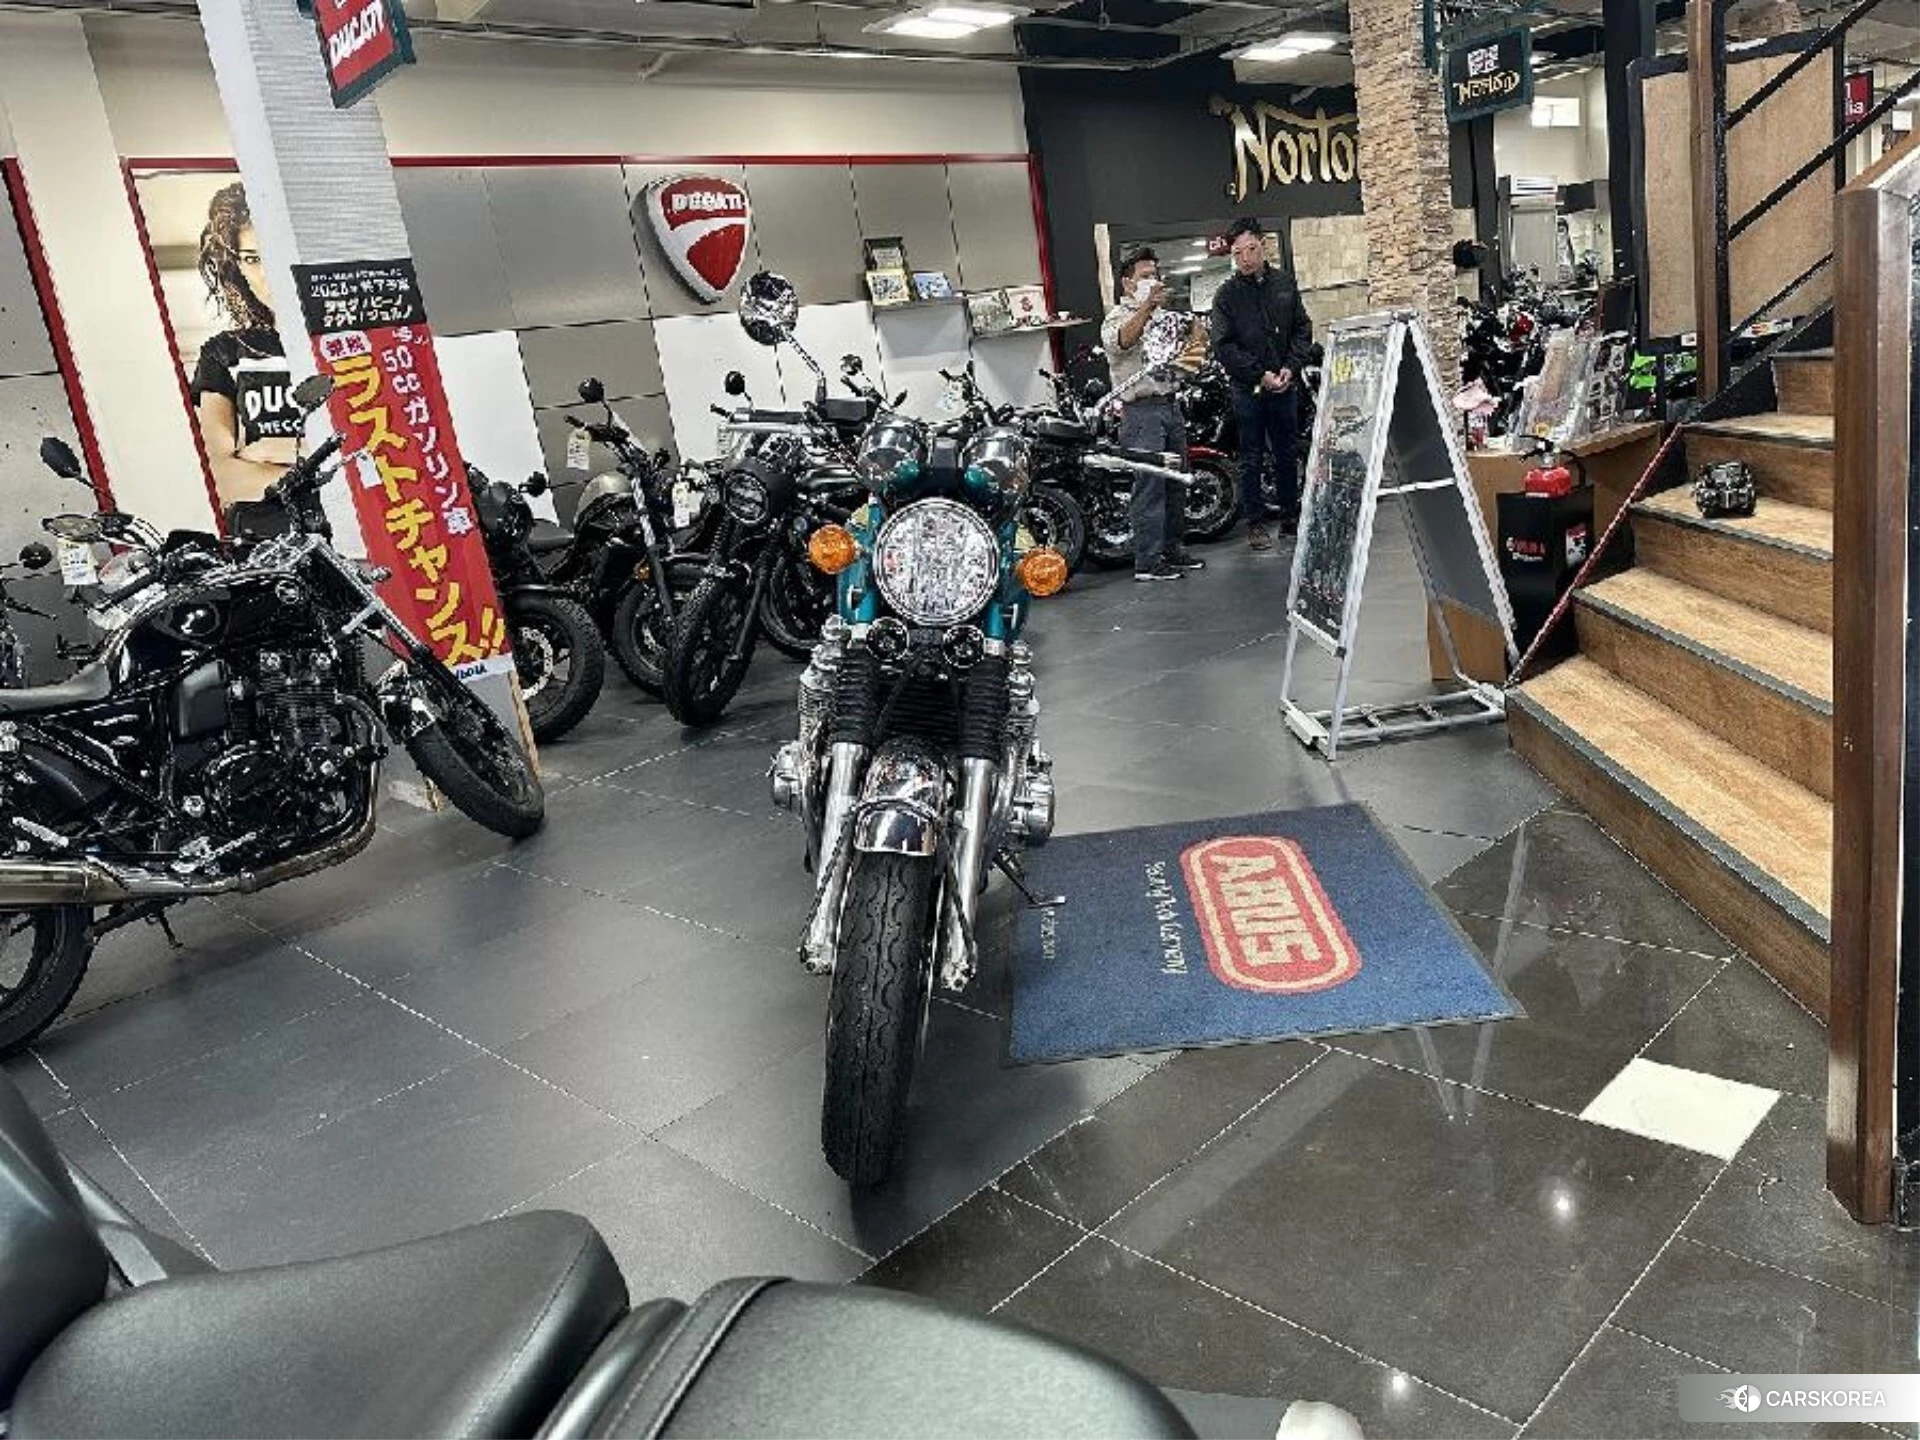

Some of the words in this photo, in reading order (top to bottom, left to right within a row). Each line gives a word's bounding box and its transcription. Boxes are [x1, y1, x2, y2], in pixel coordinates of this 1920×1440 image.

[328, 0, 385, 69] DUCATI
[1453, 70, 1520, 105] Norton
[1209, 93, 1359, 203] Norto
[245, 385, 299, 421] DUC
[258, 419, 302, 435] MECC
[1211, 854, 1322, 966] ABUS
